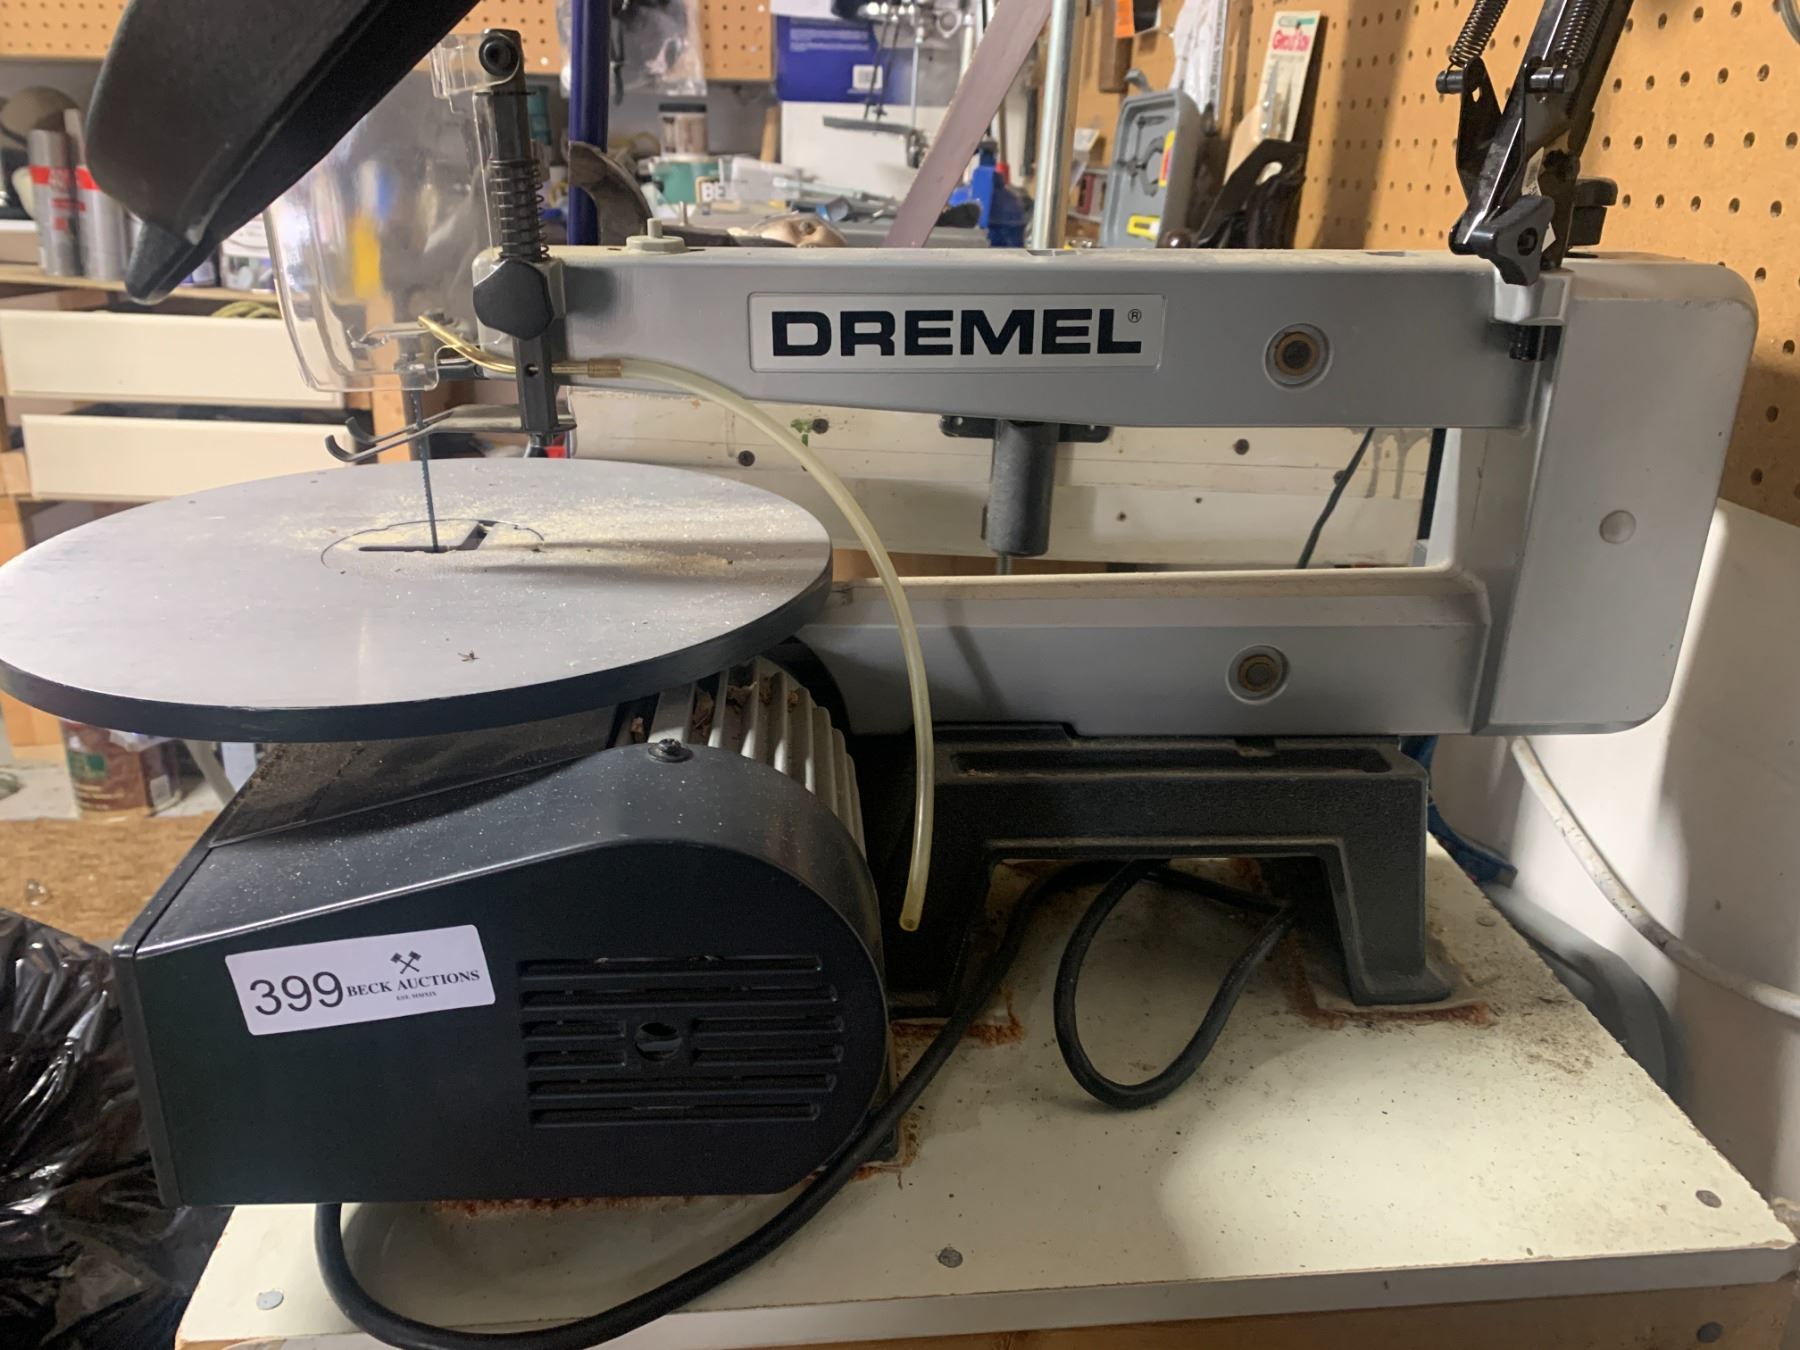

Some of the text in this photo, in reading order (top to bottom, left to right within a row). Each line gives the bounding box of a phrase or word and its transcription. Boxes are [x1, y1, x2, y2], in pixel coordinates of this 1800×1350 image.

[249, 971, 344, 1015] 399
[346, 969, 480, 997] BECK AUCTIONS
